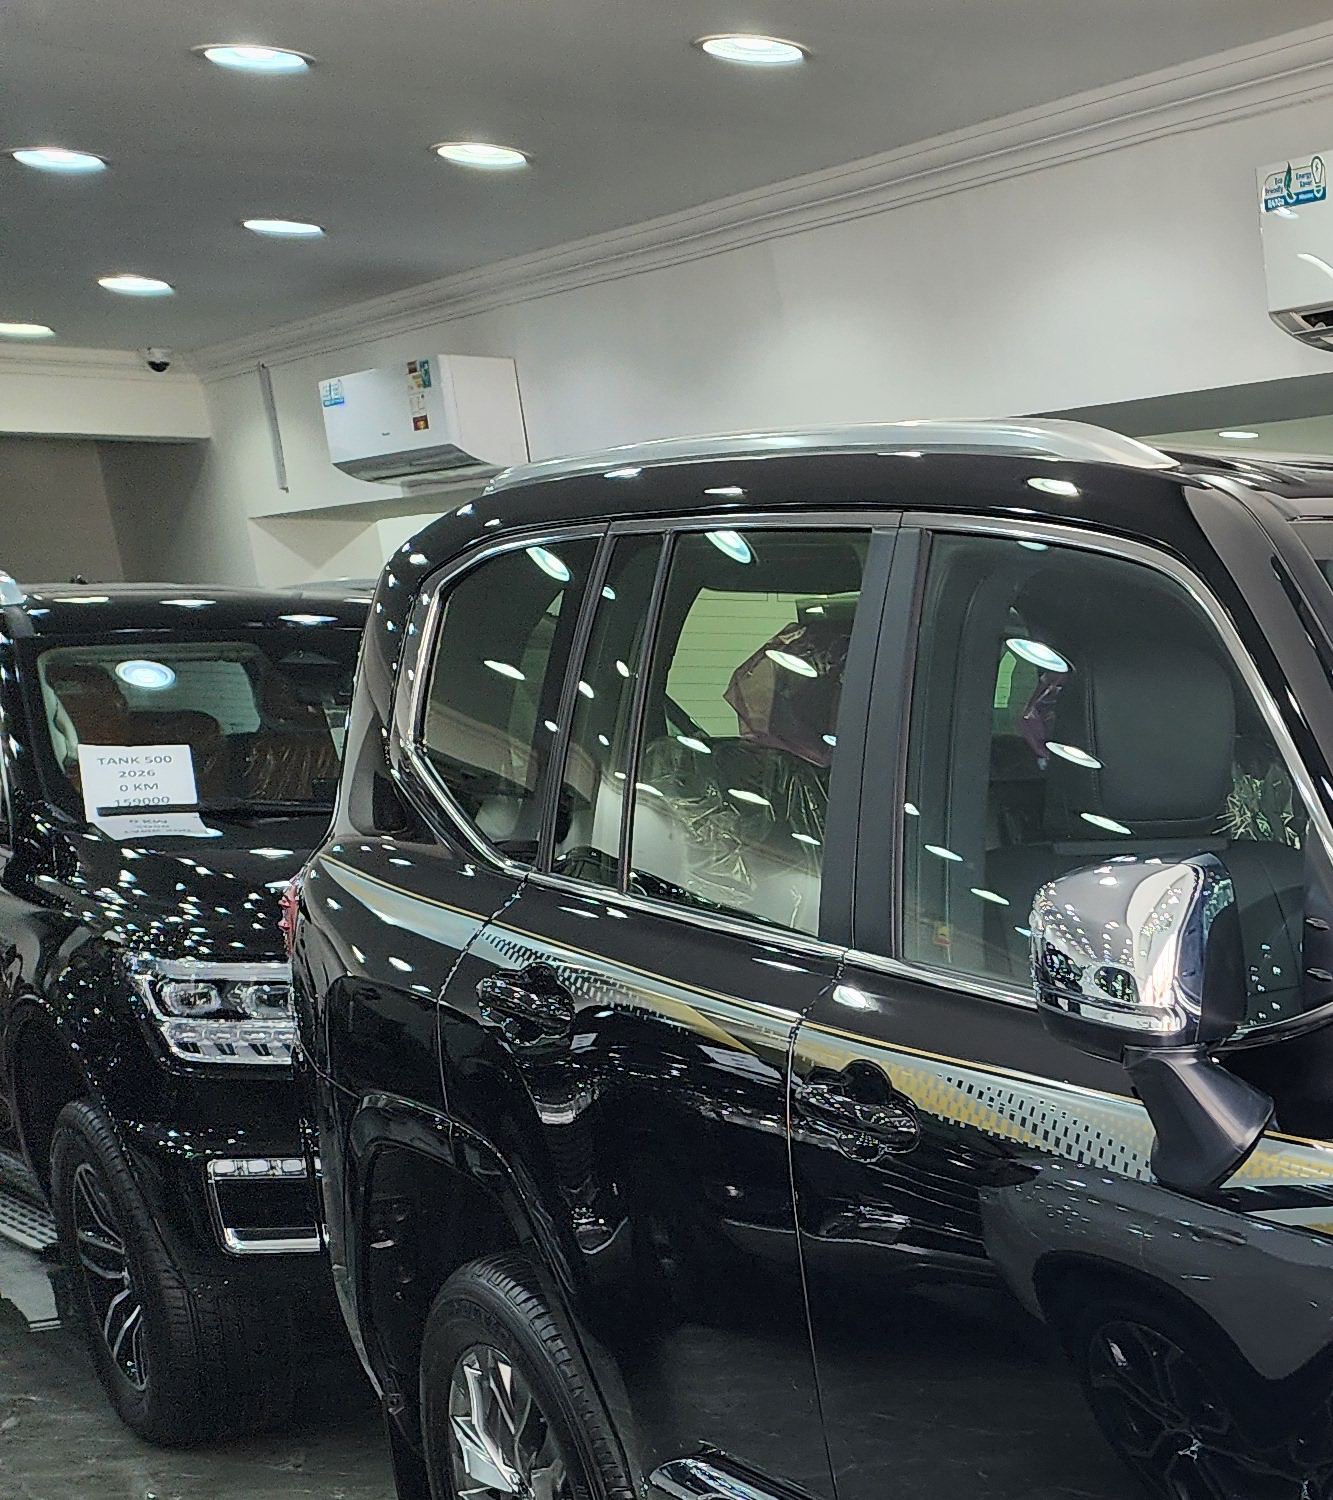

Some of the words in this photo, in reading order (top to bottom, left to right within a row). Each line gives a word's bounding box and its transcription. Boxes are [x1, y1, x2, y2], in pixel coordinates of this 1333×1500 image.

[97, 756, 141, 766] TANK
[144, 755, 173, 764] 500
[118, 769, 156, 778] 2026
[119, 784, 129, 792] 0
[133, 782, 159, 792] KM
